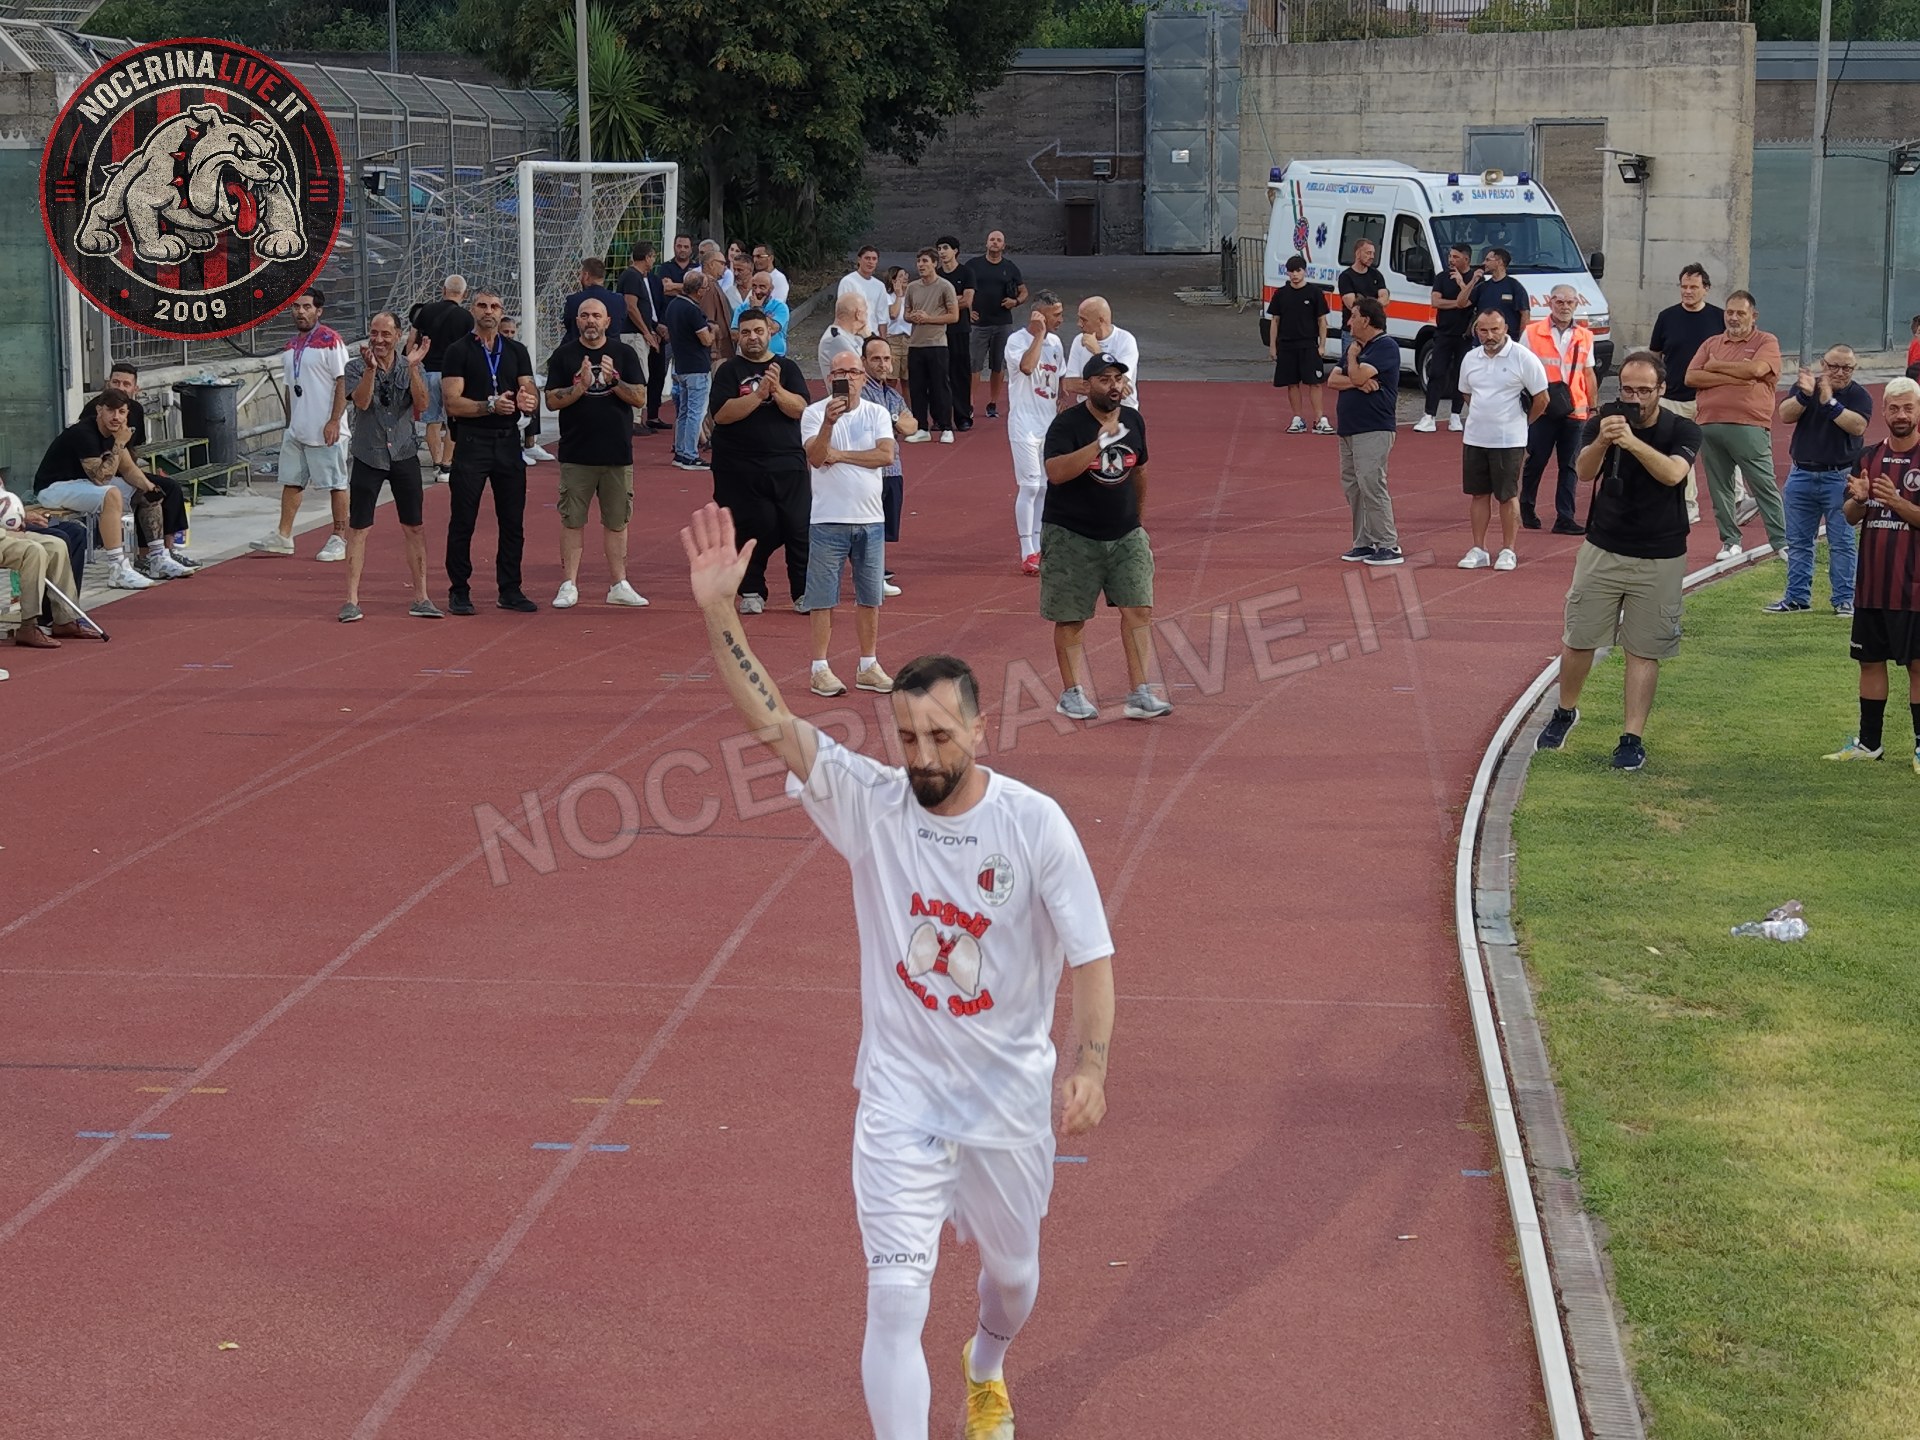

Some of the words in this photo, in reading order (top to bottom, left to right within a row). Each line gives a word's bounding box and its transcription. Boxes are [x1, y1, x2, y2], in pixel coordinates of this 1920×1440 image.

[1472, 189, 1487, 199] SAN
[1488, 189, 1515, 199] PRISCO
[1881, 509, 1892, 519] LA
[917, 828, 978, 846] GIVOVA
[910, 892, 992, 939] Angeli
[948, 989, 994, 1017] Sud
[872, 1252, 927, 1265] GIVOVA
